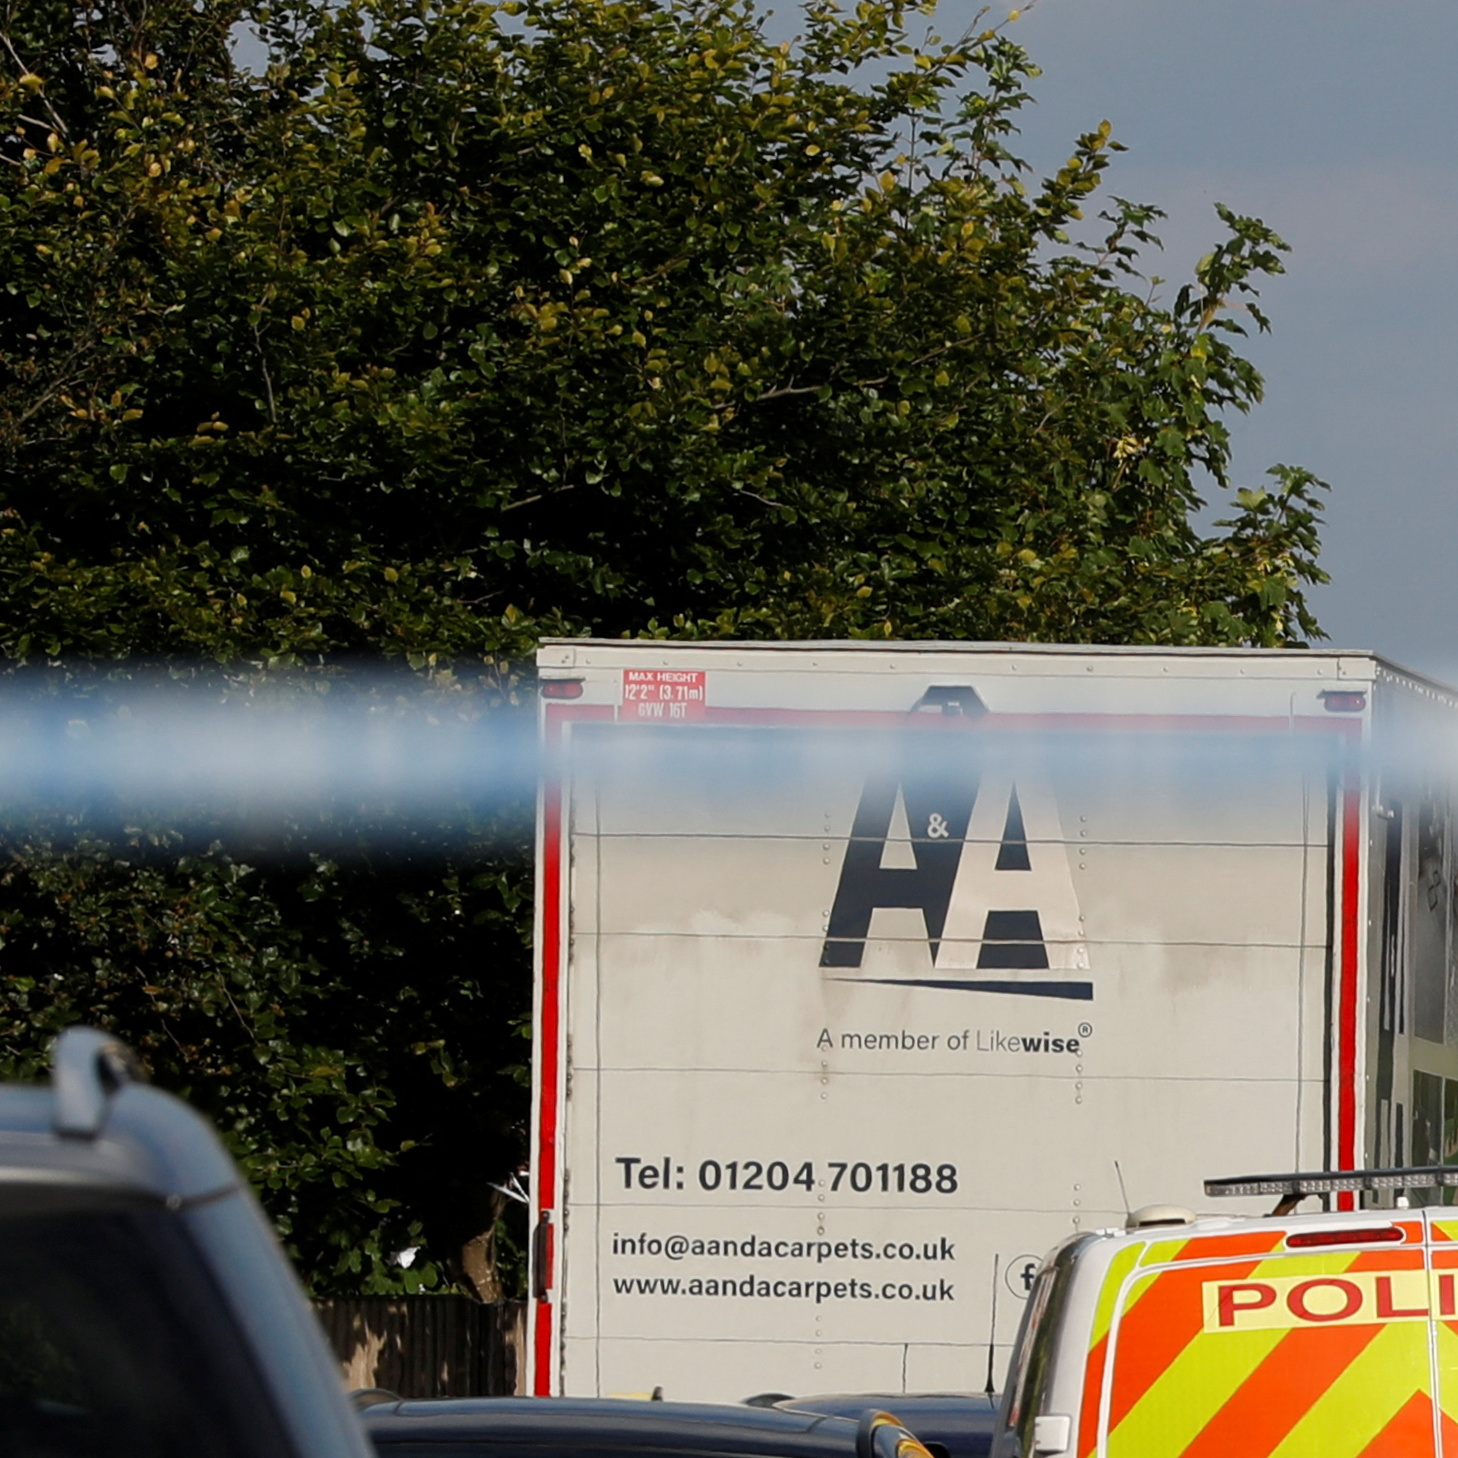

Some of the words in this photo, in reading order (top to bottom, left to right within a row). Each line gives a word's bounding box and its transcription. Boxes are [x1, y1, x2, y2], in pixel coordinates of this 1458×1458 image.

[628, 671, 654, 682] MAX
[657, 672, 699, 683] HEIGHT
[638, 701, 665, 718] GVW
[669, 702, 688, 719] 16T
[816, 1028, 834, 1050] A
[841, 1030, 940, 1051] member
[947, 1029, 970, 1051] of
[615, 1157, 685, 1190] Tel:
[699, 1161, 815, 1192] 01204
[827, 1162, 959, 1194] 701188
[612, 1232, 956, 1263] info@aandacarpets.co.uk
[613, 1275, 955, 1303] www.aandacarpets.co.uk
